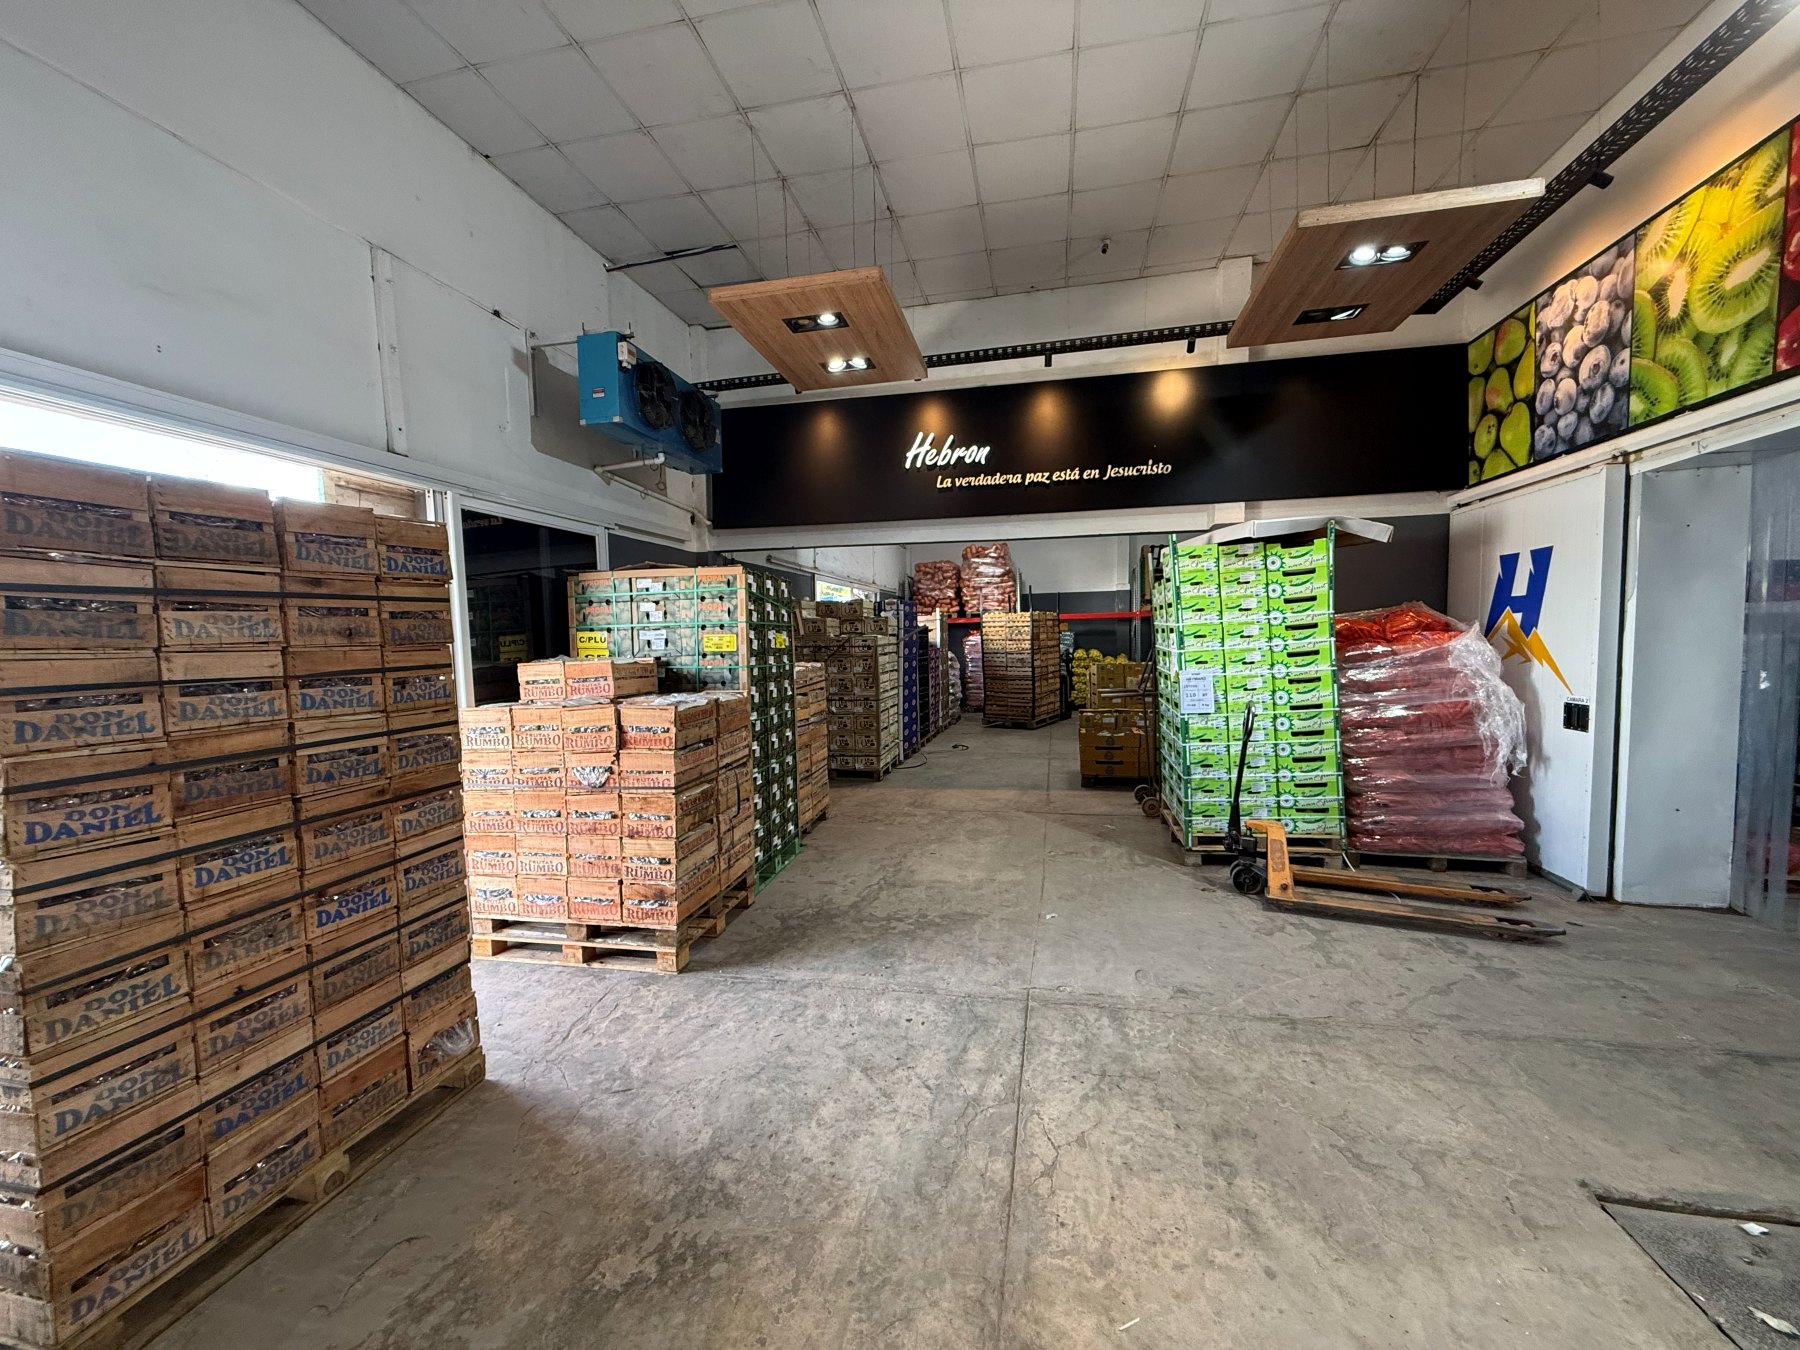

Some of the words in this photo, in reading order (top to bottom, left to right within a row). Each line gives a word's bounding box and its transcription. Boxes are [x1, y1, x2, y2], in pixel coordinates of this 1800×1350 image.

[904, 431, 990, 469] Hebron
[936, 475, 952, 488] La
[955, 472, 1022, 488] verdadera
[1025, 471, 1050, 486] paz
[1052, 467, 1080, 482] está
[1083, 469, 1100, 480] en
[1103, 459, 1172, 480] Jesucristo
[295, 541, 376, 571] DANIEL
[403, 555, 434, 564] DON
[386, 556, 448, 577] DANIEL
[172, 616, 278, 638] DANIEL
[578, 636, 607, 644] C/PLU
[323, 687, 361, 698] DON
[392, 683, 451, 704] DANIEL
[524, 686, 564, 698] RUMBO
[570, 683, 611, 696] RUMBO
[178, 697, 284, 722] DANIEL
[300, 690, 380, 711] DANIEL
[55, 709, 126, 725] DON
[13, 711, 156, 744] DANIEL
[466, 735, 510, 747] RUMBO
[516, 734, 561, 746] RUMBO
[565, 735, 613, 748] RUMBO
[329, 757, 368, 770] DON
[399, 749, 460, 769] DANIEL
[306, 757, 385, 785] DANIEL
[64, 803, 131, 822] DON
[400, 803, 459, 834] DANIEL
[417, 804, 446, 819] DON
[23, 801, 161, 845] DANIEL
[336, 825, 374, 841] DON
[469, 819, 514, 832] RUMBO
[518, 820, 565, 834] RUMBO
[314, 825, 390, 860] DANIEL
[222, 847, 271, 866] DON
[471, 858, 515, 872] RUMBO
[519, 860, 564, 873] RUMBO
[193, 845, 292, 889] DANIEL
[404, 860, 463, 892] DANIEL
[421, 862, 450, 877] DON
[624, 865, 674, 880] RUMBO
[316, 887, 392, 929] DANIEL
[338, 889, 375, 909] DON
[473, 900, 516, 913] RUMBO
[522, 902, 566, 915] RUMBO
[626, 908, 674, 922] RUMBO
[83, 978, 150, 1012] DON
[43, 973, 182, 1045] DANIEL
[327, 1014, 402, 1070] DANIEL
[347, 1022, 383, 1046] DON
[54, 1059, 190, 1138] DANIEL
[214, 1072, 310, 1137] DANIEL
[70, 1229, 199, 1326] DANIEL
